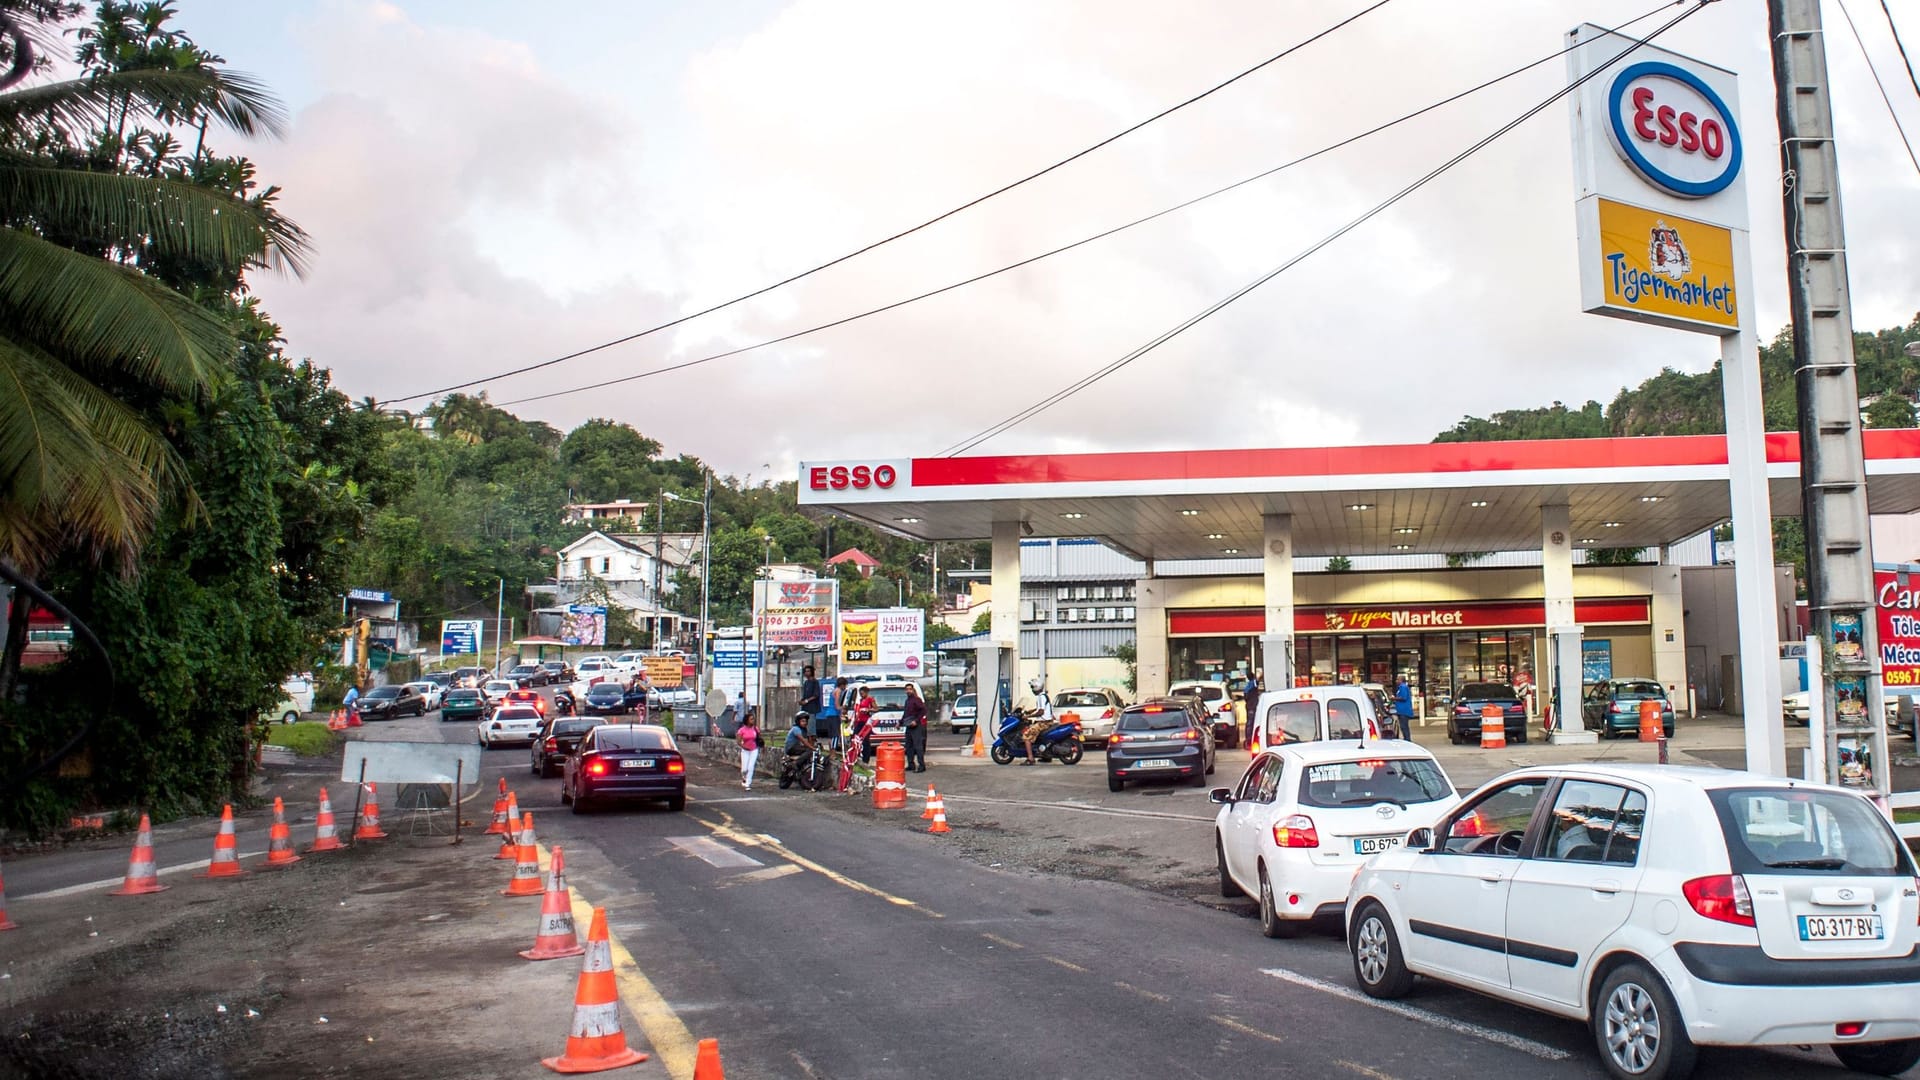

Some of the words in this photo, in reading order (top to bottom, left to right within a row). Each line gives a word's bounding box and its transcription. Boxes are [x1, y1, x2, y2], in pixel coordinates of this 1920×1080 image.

[1607, 252, 1734, 315] Tigermarket
[810, 464, 897, 489] ESSO
[787, 616, 799, 625] 73
[803, 615, 815, 625] 56
[819, 615, 831, 625] 61
[882, 615, 918, 624] ILLIMITÉ
[1391, 609, 1463, 626] Market
[882, 624, 918, 633] 24H/24
[844, 638, 876, 647] ANGEL
[849, 651, 860, 660] 39
[1886, 671, 1911, 684] 0596
